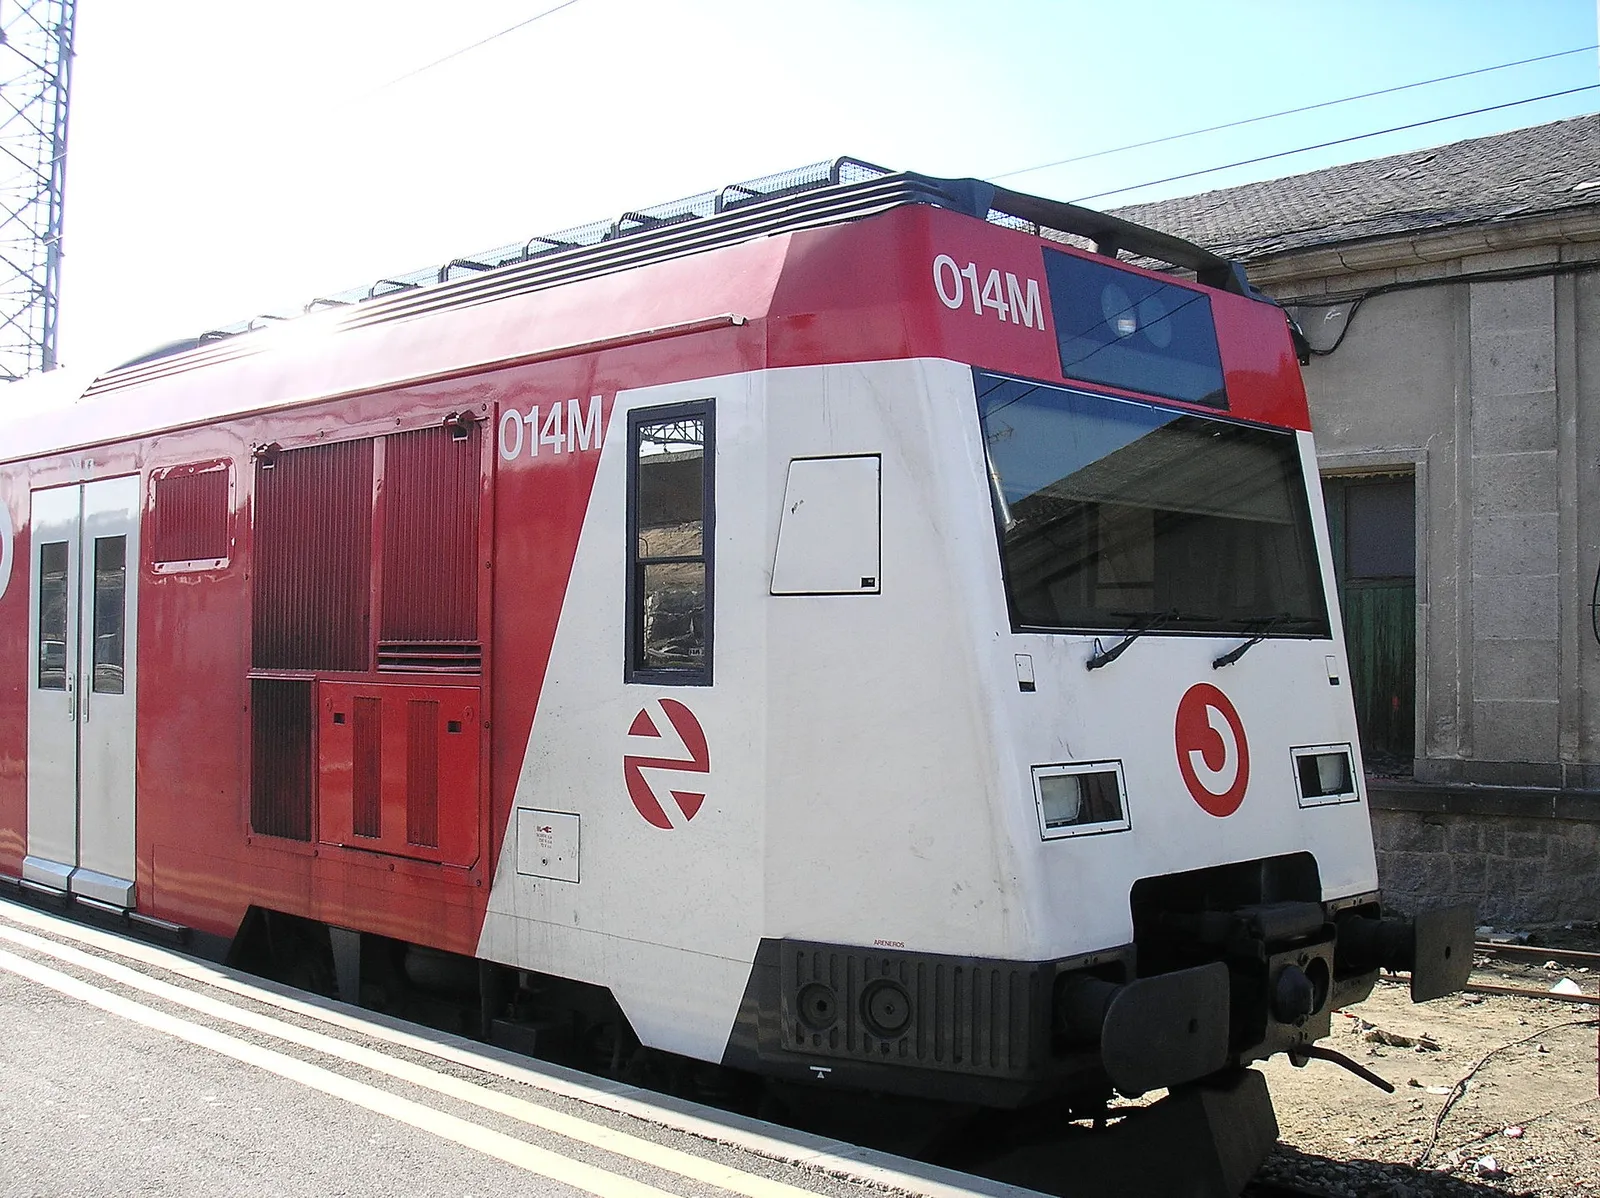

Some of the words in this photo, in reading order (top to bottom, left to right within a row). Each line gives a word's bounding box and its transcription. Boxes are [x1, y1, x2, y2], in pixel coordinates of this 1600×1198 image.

[933, 254, 1045, 331] 014M
[498, 394, 602, 461] 014M
[873, 939, 905, 948] ARENEROS
